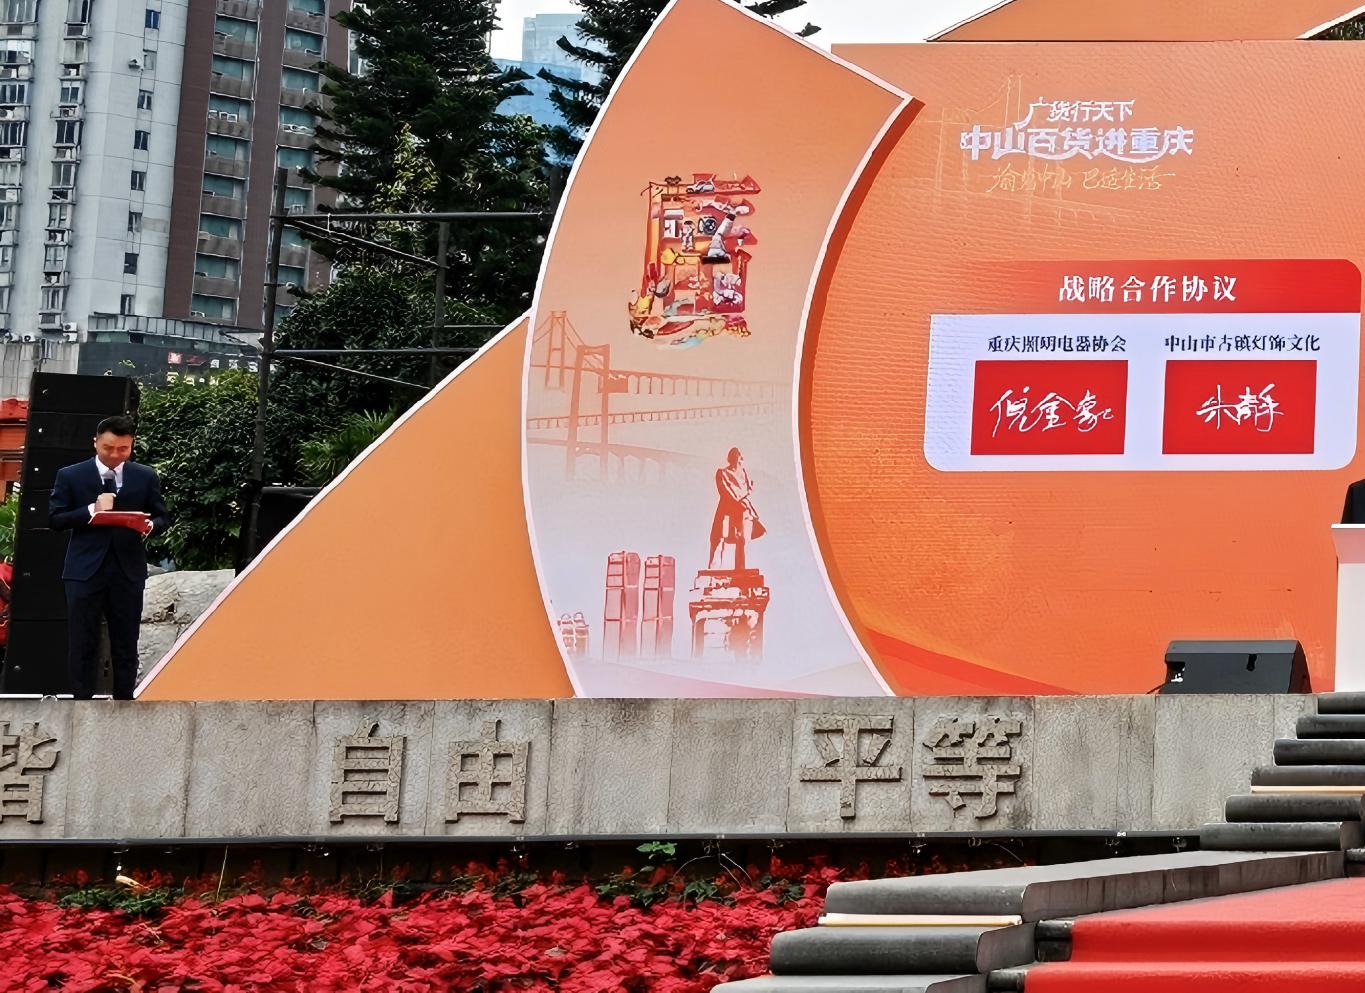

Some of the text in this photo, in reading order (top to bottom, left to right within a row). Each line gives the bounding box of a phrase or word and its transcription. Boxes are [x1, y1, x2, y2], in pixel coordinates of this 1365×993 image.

[1013, 97, 1136, 130] 广货行天下
[960, 124, 1194, 164] 中山百货进重庆
[1059, 276, 1237, 303] 战略合作协议
[329, 719, 531, 826] 自由
[800, 713, 1024, 822] 平等
